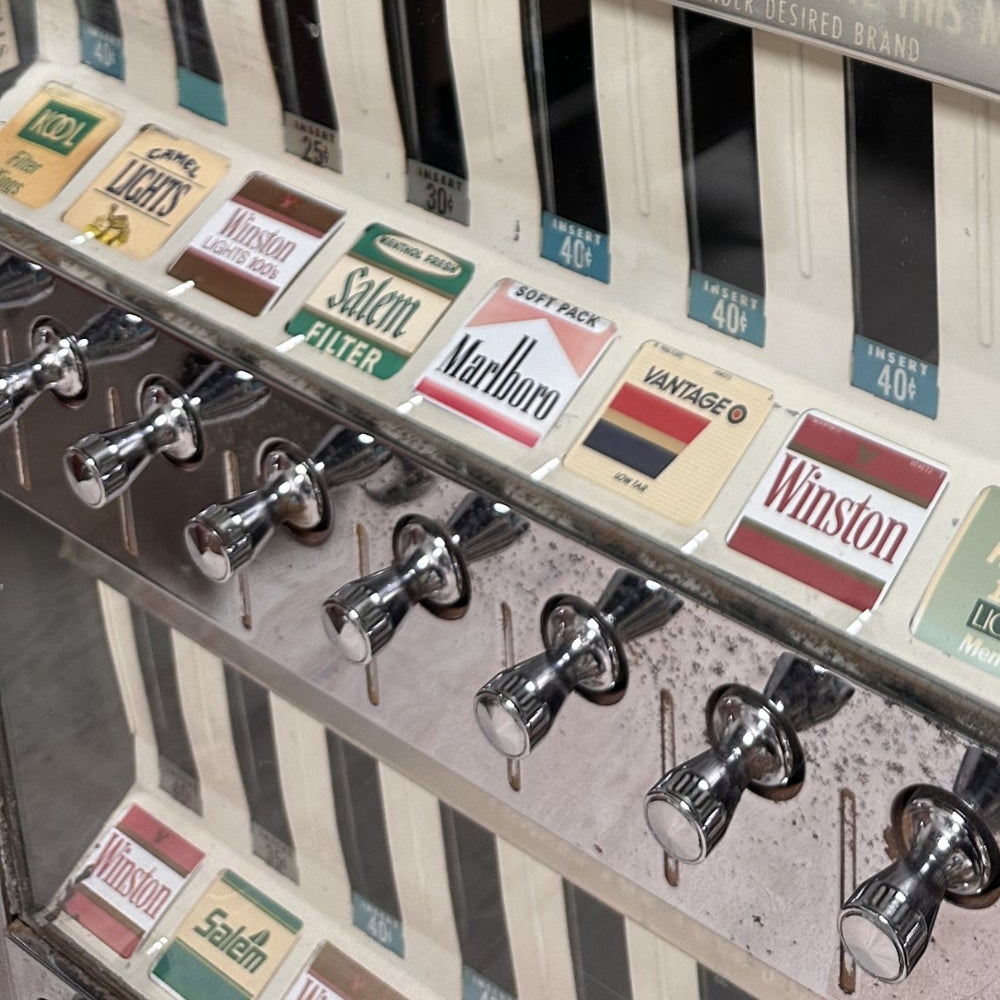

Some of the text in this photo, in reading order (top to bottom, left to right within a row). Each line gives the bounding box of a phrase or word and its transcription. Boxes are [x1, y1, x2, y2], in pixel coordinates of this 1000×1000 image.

[855, 22, 920, 63] BRAND
[31, 108, 87, 147] KOOL
[147, 147, 202, 179] CAMEL
[418, 166, 462, 191] INSERT
[105, 159, 191, 218] LIGHTS
[202, 235, 250, 266] LIGHTS
[219, 208, 297, 263] Winston
[552, 218, 601, 246] INSERT
[559, 235, 593, 270] 40¢
[327, 265, 421, 339] Salem
[514, 285, 600, 328] SOFT PACK
[703, 279, 758, 310] INSERT
[711, 298, 748, 334] 40¢
[304, 319, 384, 374] FILTER
[868, 343, 929, 376] INSERT
[436, 333, 561, 421] Marlboro
[643, 365, 732, 415] VANTAGE
[877, 366, 916, 401] 40¢
[763, 452, 908, 565] Winston
[93, 831, 172, 920] Winston
[193, 907, 269, 974] Salem
